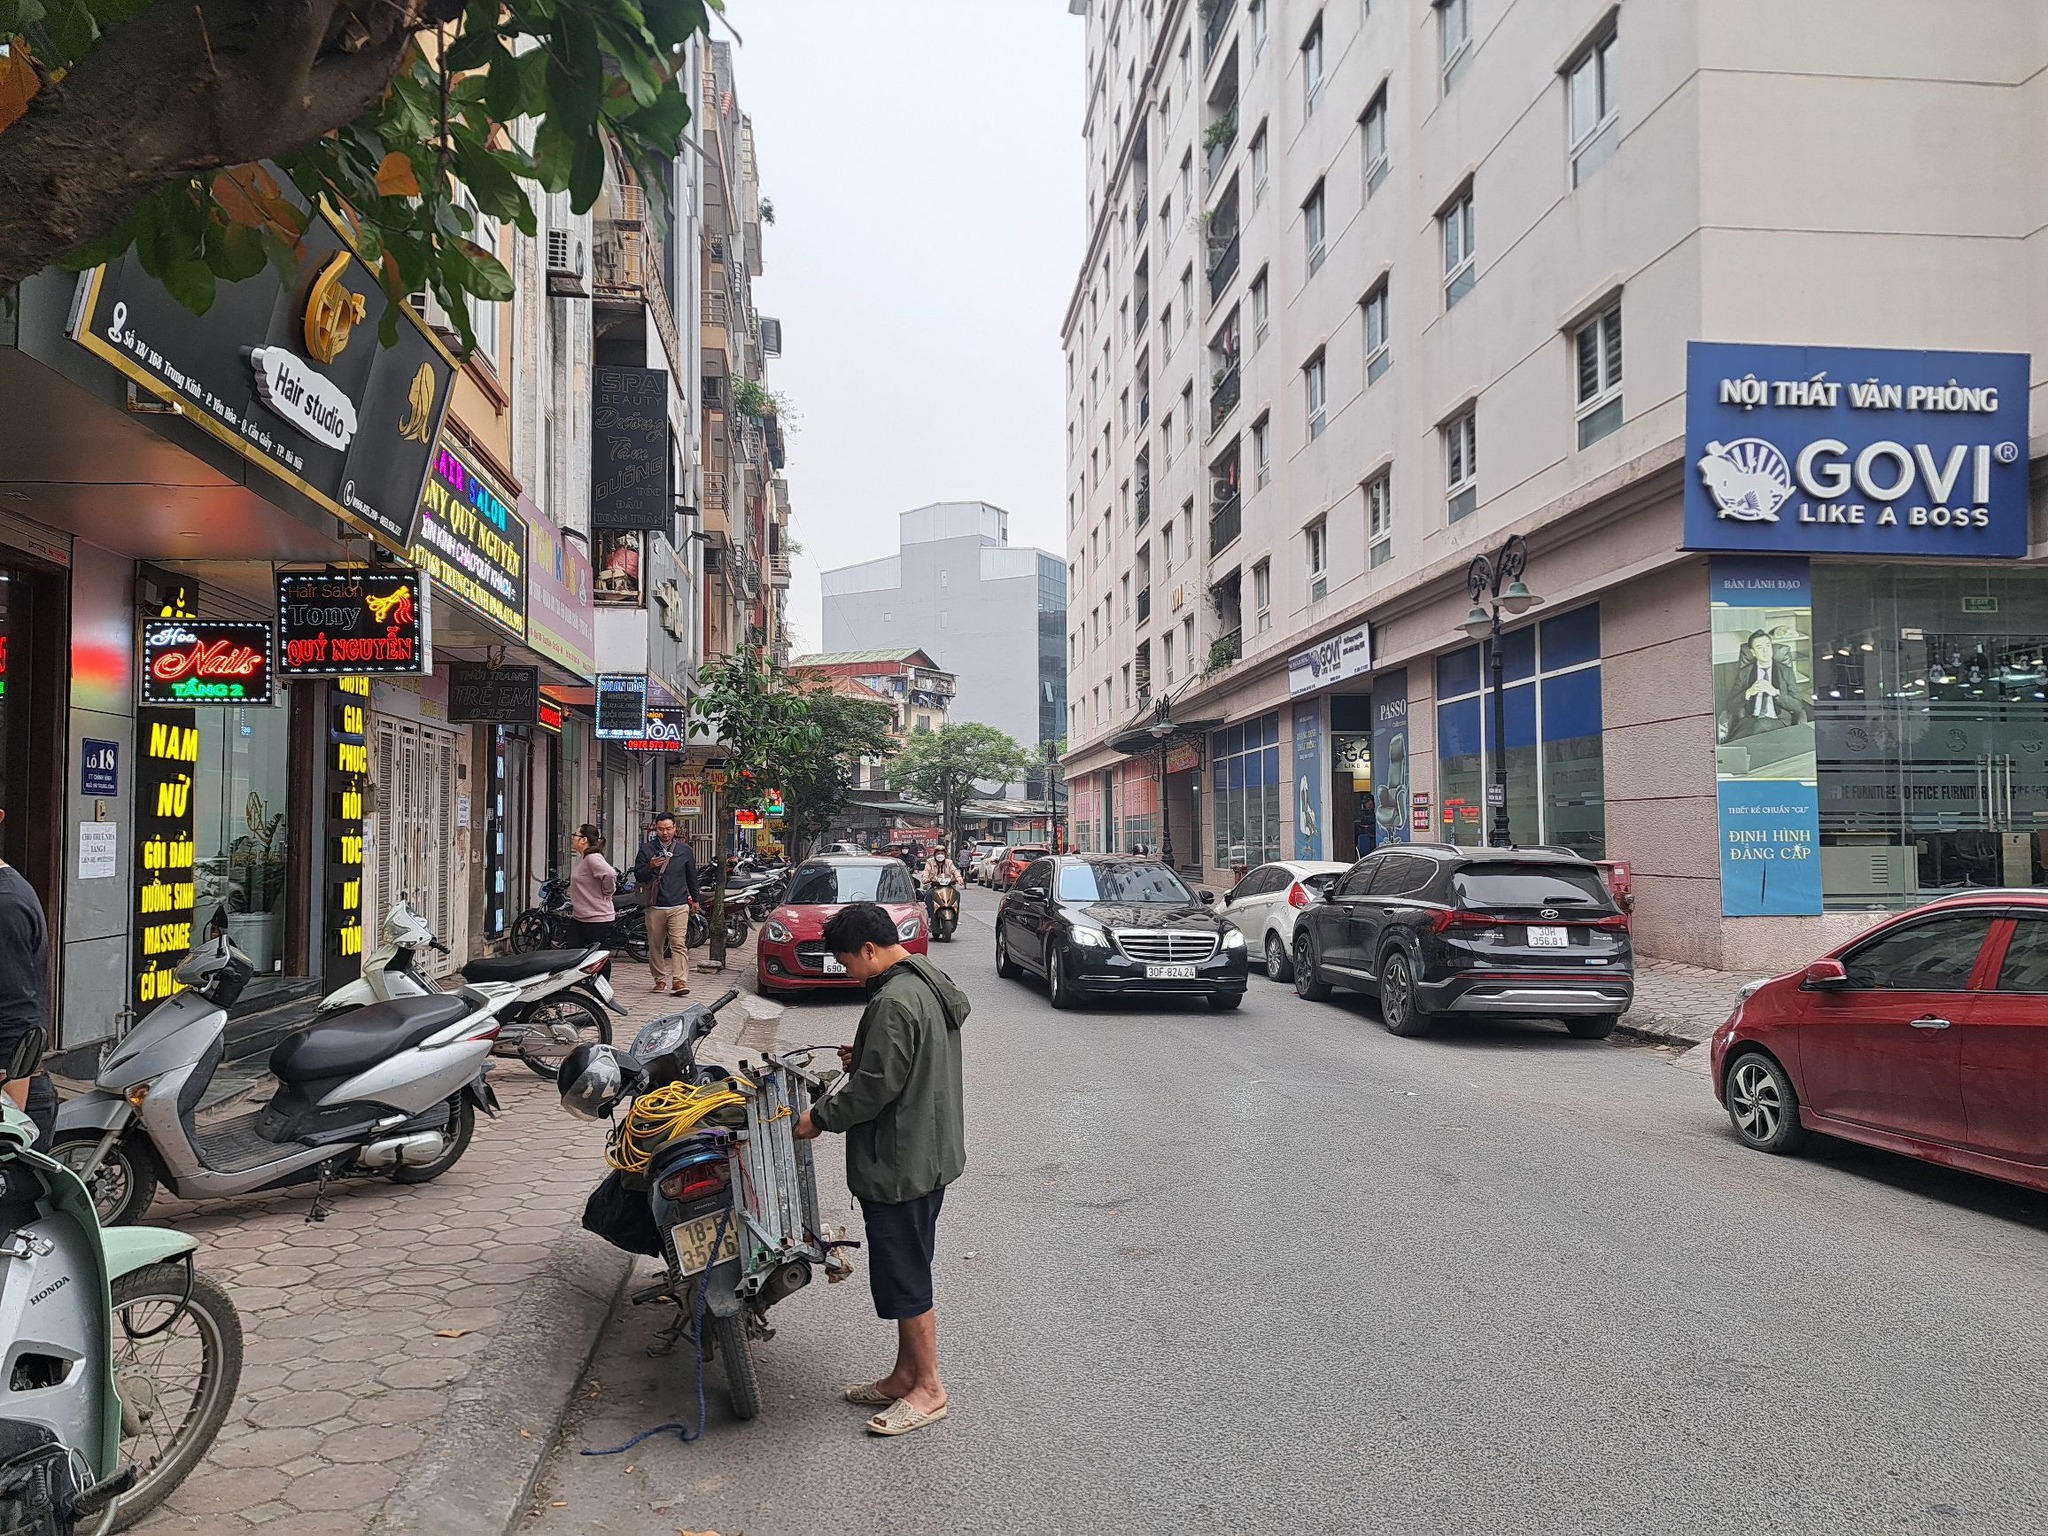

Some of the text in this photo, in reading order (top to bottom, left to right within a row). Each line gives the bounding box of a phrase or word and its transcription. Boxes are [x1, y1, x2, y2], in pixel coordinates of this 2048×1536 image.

[123, 330, 135, 349] Số
[148, 350, 163, 370] 168
[164, 361, 185, 389] Trung
[185, 377, 201, 398] Kính
[205, 392, 212, 407] P.
[276, 444, 284, 458] TP.
[602, 373, 661, 394] SPA
[1719, 371, 1998, 412] NỘI THẤT VĂN PHÒNG
[275, 362, 344, 438] Hair studio
[601, 394, 662, 406] BEAUTY
[596, 456, 663, 501] DƯỠNG
[1796, 438, 1991, 505] GOVI
[433, 449, 507, 532] AIR SALON
[1800, 503, 1990, 528] LIKE A BOSS
[450, 499, 477, 542] QUÝ
[477, 521, 520, 578] NGUYỄN
[289, 583, 363, 598] Hair Salon
[1724, 578, 1744, 589] BÀN
[1777, 579, 1800, 590] ĐẠO
[288, 604, 362, 631] Tony
[150, 627, 198, 645] Hoa
[287, 626, 412, 666] QUÝ NGUYỄN
[154, 639, 263, 678] Nails
[229, 684, 244, 697] 2
[489, 671, 529, 681] TRANG
[455, 681, 532, 706] TRẺ EM
[344, 704, 363, 734] GIA
[1380, 699, 1407, 721] PASSO
[150, 722, 198, 762] NAM
[628, 740, 648, 749] 0978
[649, 740, 664, 749] 573
[86, 748, 115, 770] LÔ 18
[339, 743, 367, 780] PHỤC
[157, 773, 191, 818] NỮ
[342, 780, 362, 820] HỒI
[677, 798, 697, 806] NGON
[1904, 785, 1939, 800] OFFICE
[1727, 805, 1749, 814] THIẾT
[1750, 805, 1761, 814] KẾ
[1762, 804, 1790, 814] CHUẨN
[341, 828, 362, 864] TÓC
[1729, 827, 1811, 844] ĐỊNH HÌNH
[144, 834, 167, 877] GỘI
[1730, 843, 1811, 860] ĐẲNG CẤP
[142, 878, 194, 914] DƯỠNG SINH
[343, 877, 360, 910] HƯ
[144, 922, 191, 955] MASSAGE
[340, 916, 362, 956] TỔN
[1533, 937, 1564, 945] 356.81
[1539, 927, 1556, 936] 30H
[141, 960, 157, 1002] CỔ
[157, 969, 172, 998] VAI
[694, 1201, 716, 1211] HONDA
[29, 1276, 70, 1306] HONDA
